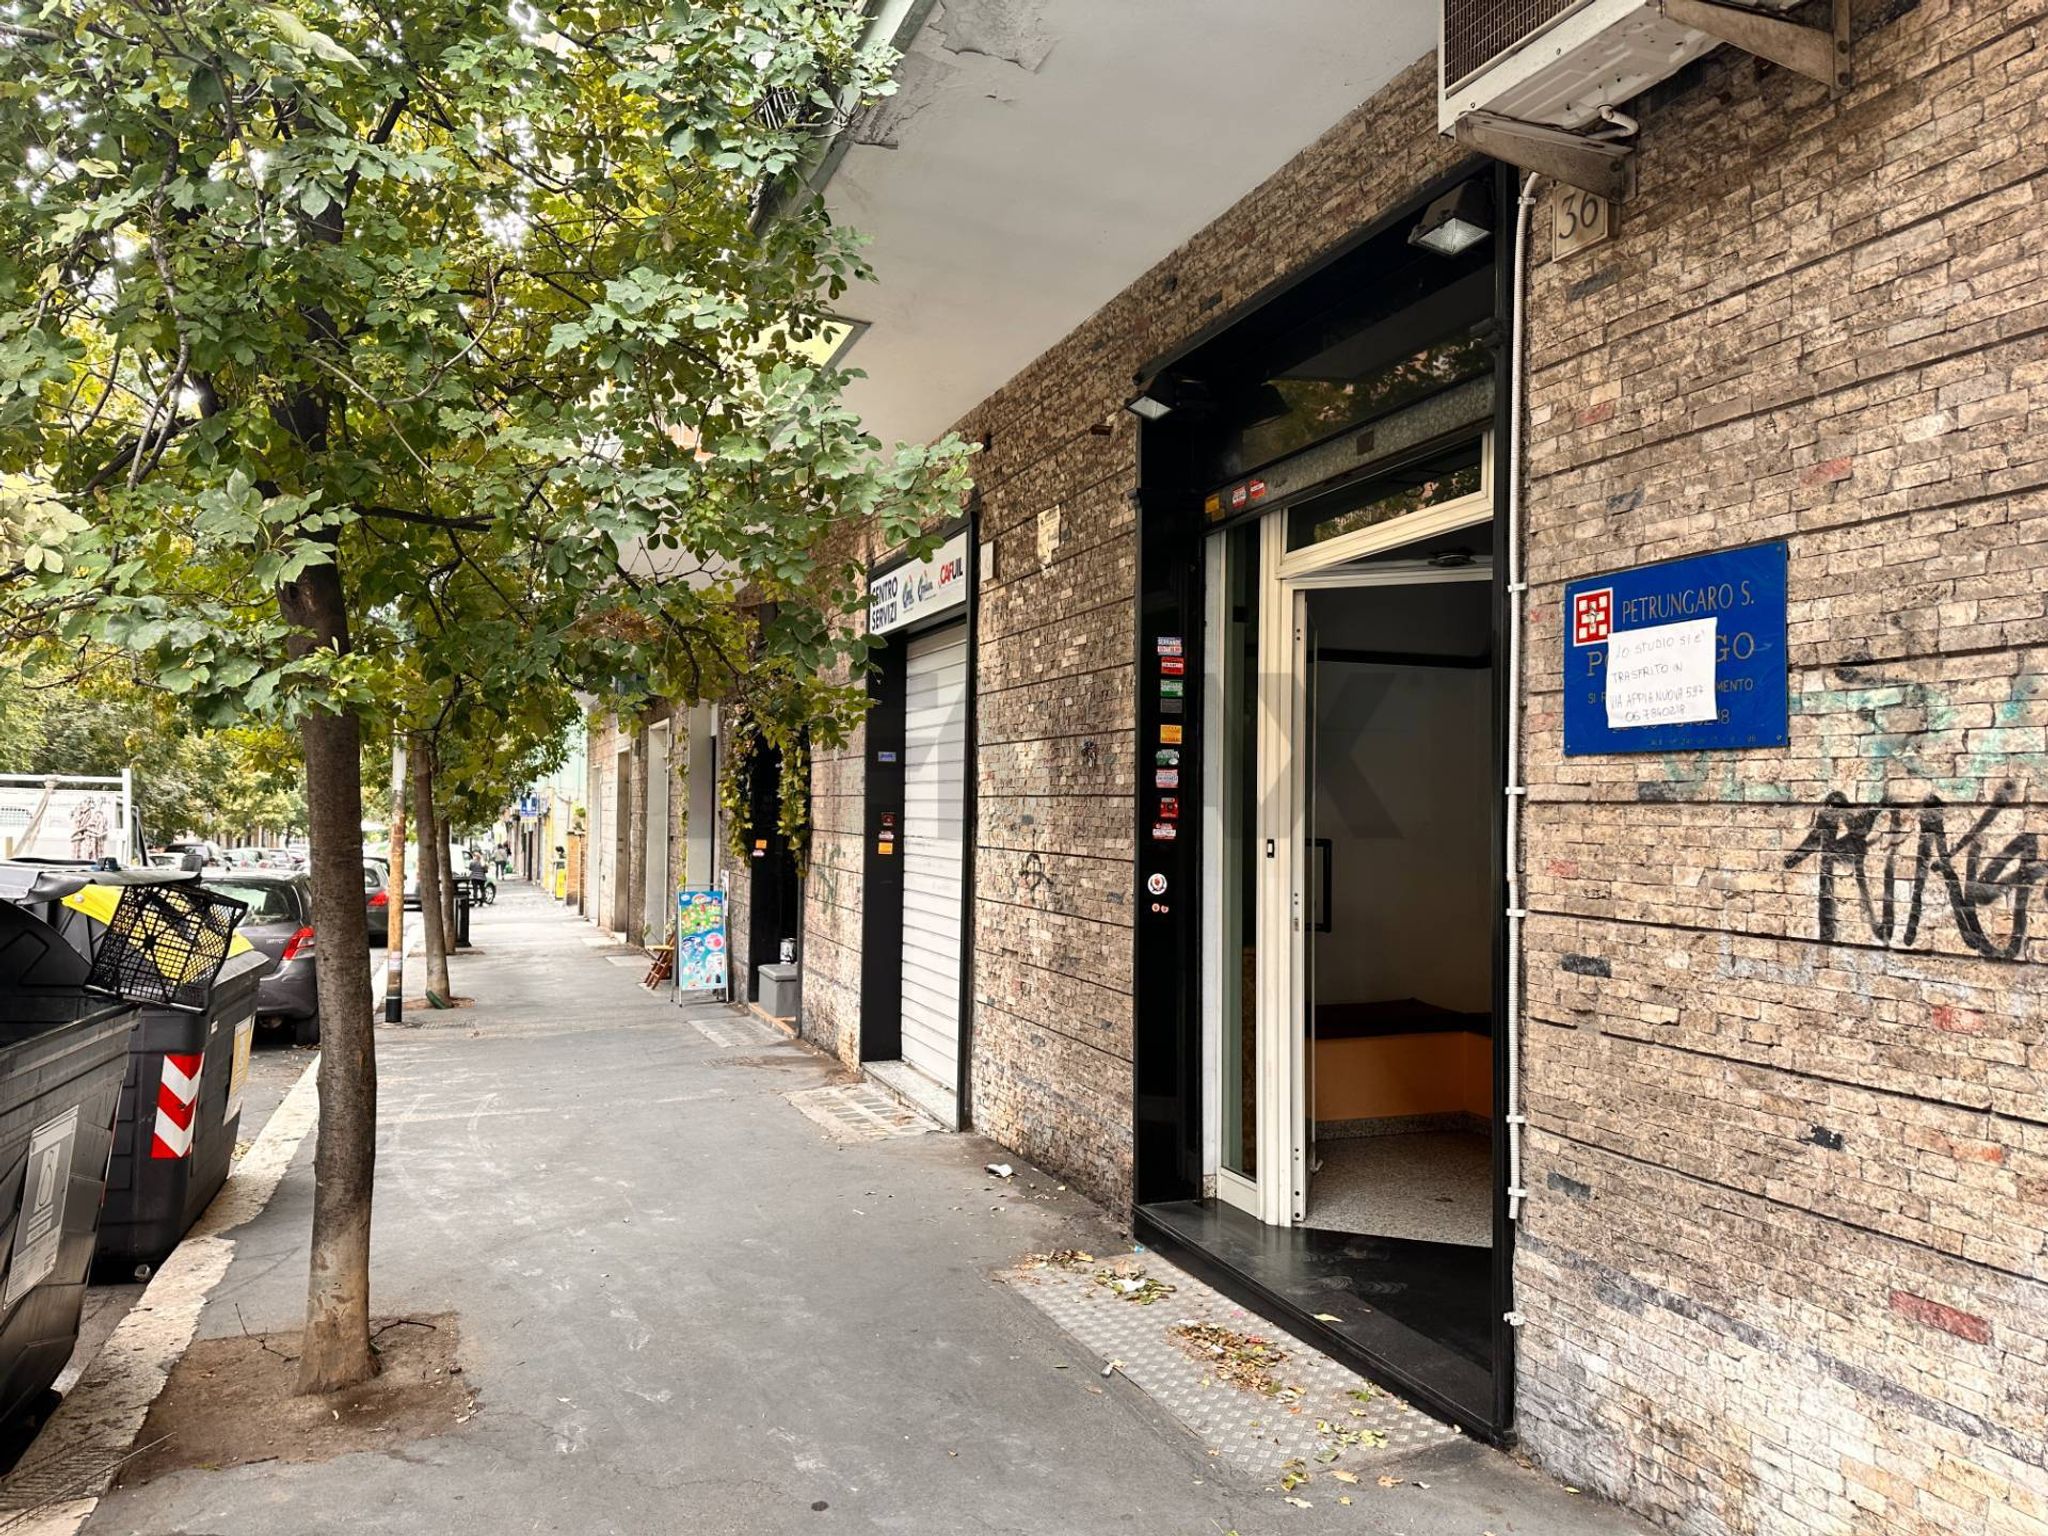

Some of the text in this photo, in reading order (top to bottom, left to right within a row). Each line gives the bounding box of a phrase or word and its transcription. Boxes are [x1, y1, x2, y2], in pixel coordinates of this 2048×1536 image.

[1559, 192, 1598, 239] 36
[872, 576, 898, 608] CENTRO
[1622, 580, 1755, 625] PETRUNGARO S.
[872, 601, 897, 631] SERVIZI
[1635, 637, 1674, 654] STUDIO
